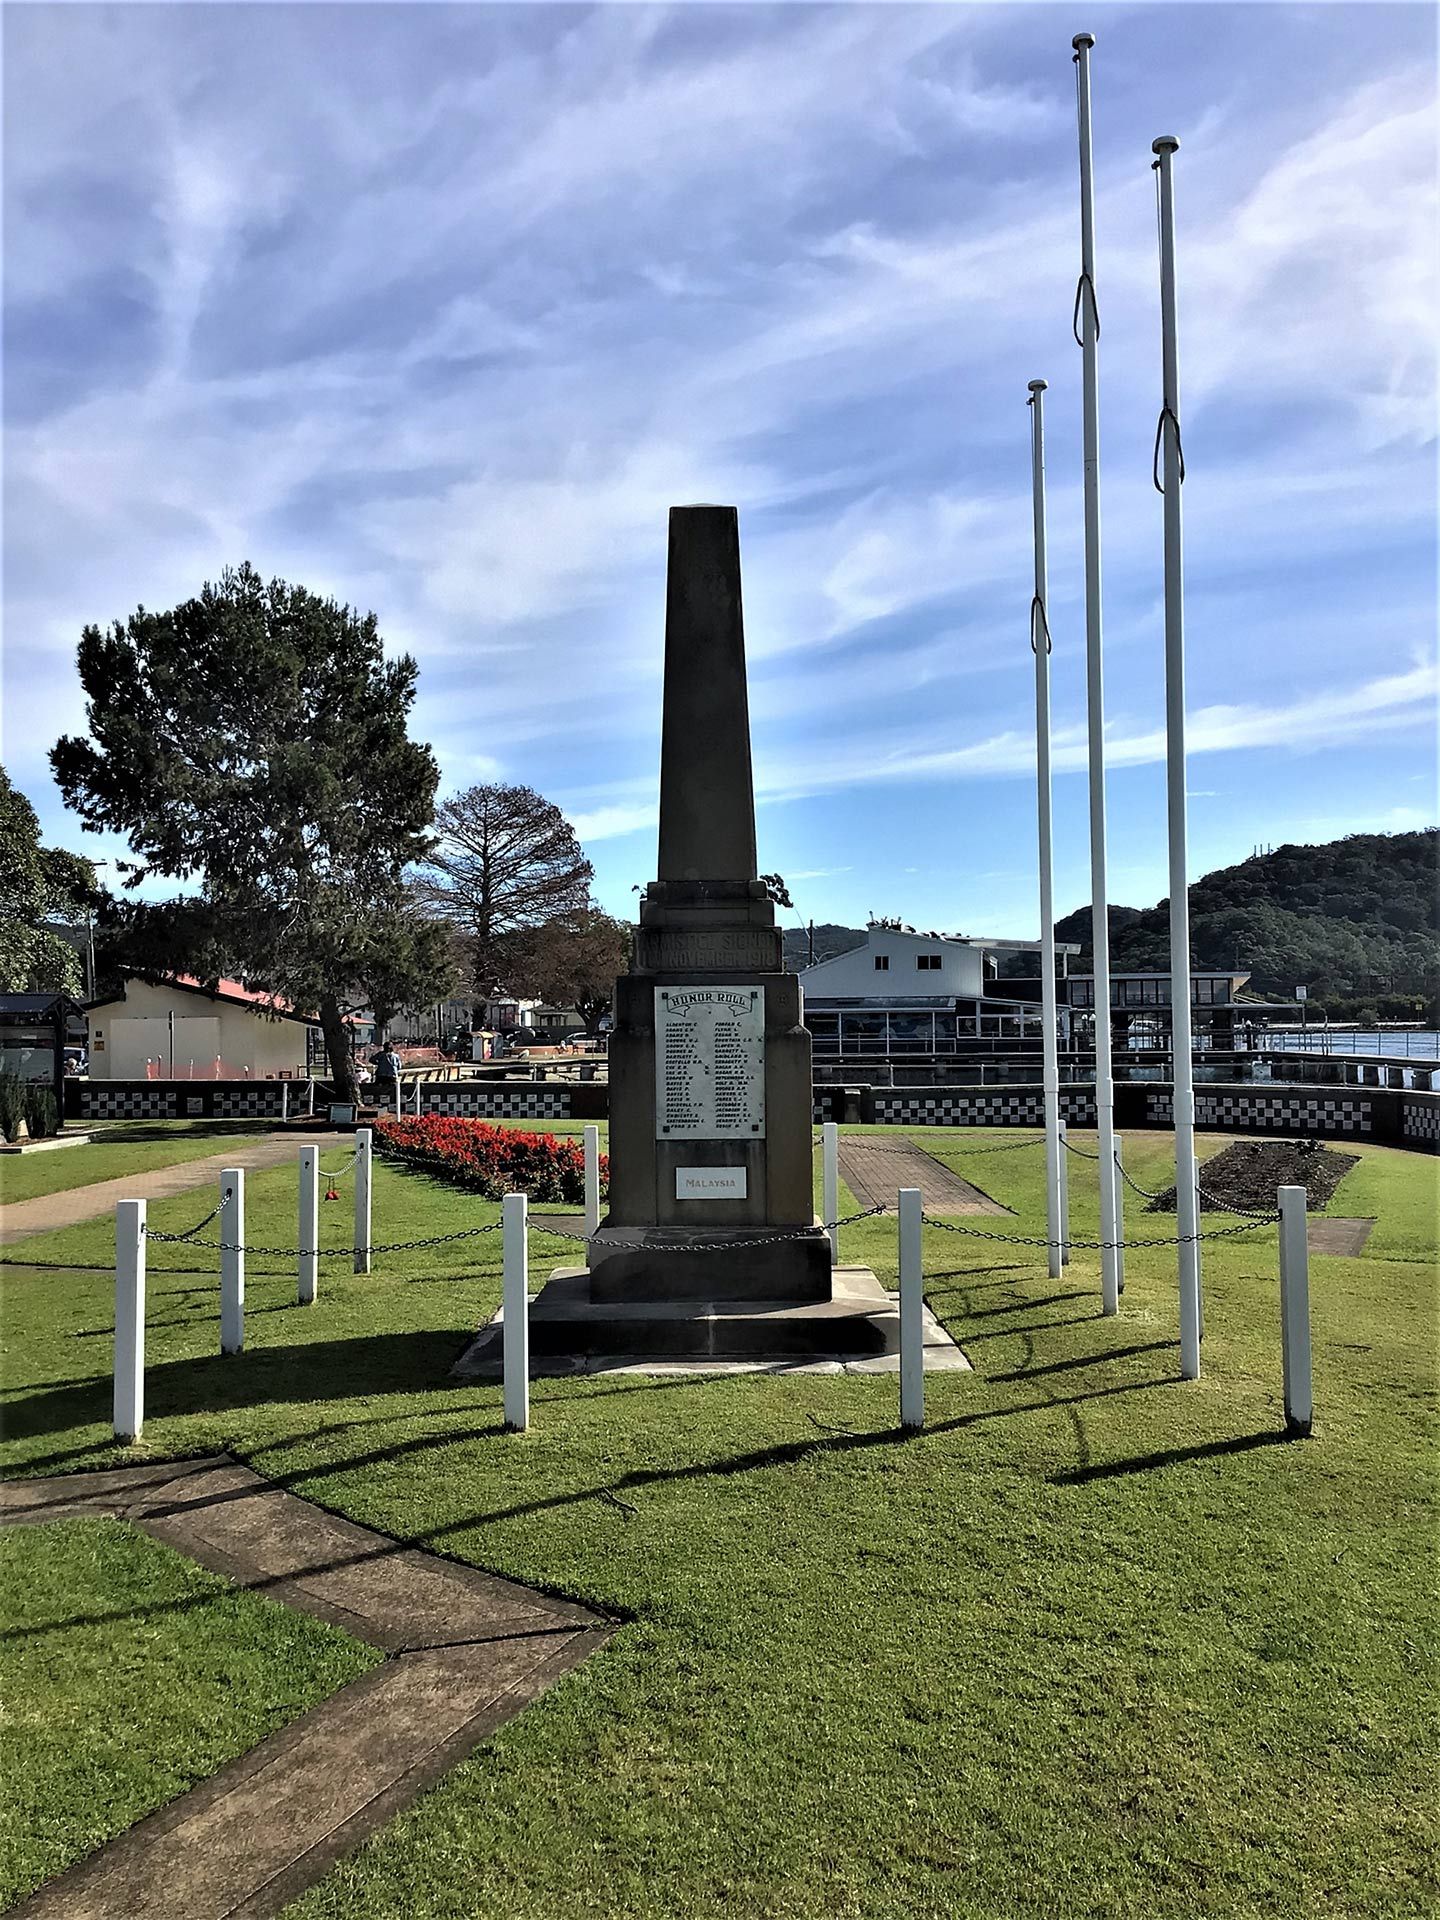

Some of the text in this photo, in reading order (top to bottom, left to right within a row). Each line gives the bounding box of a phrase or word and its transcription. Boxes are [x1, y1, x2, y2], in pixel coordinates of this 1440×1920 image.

[671, 993, 747, 1007] HONOR ROLL
[685, 1178, 736, 1188] MALAYSIA
